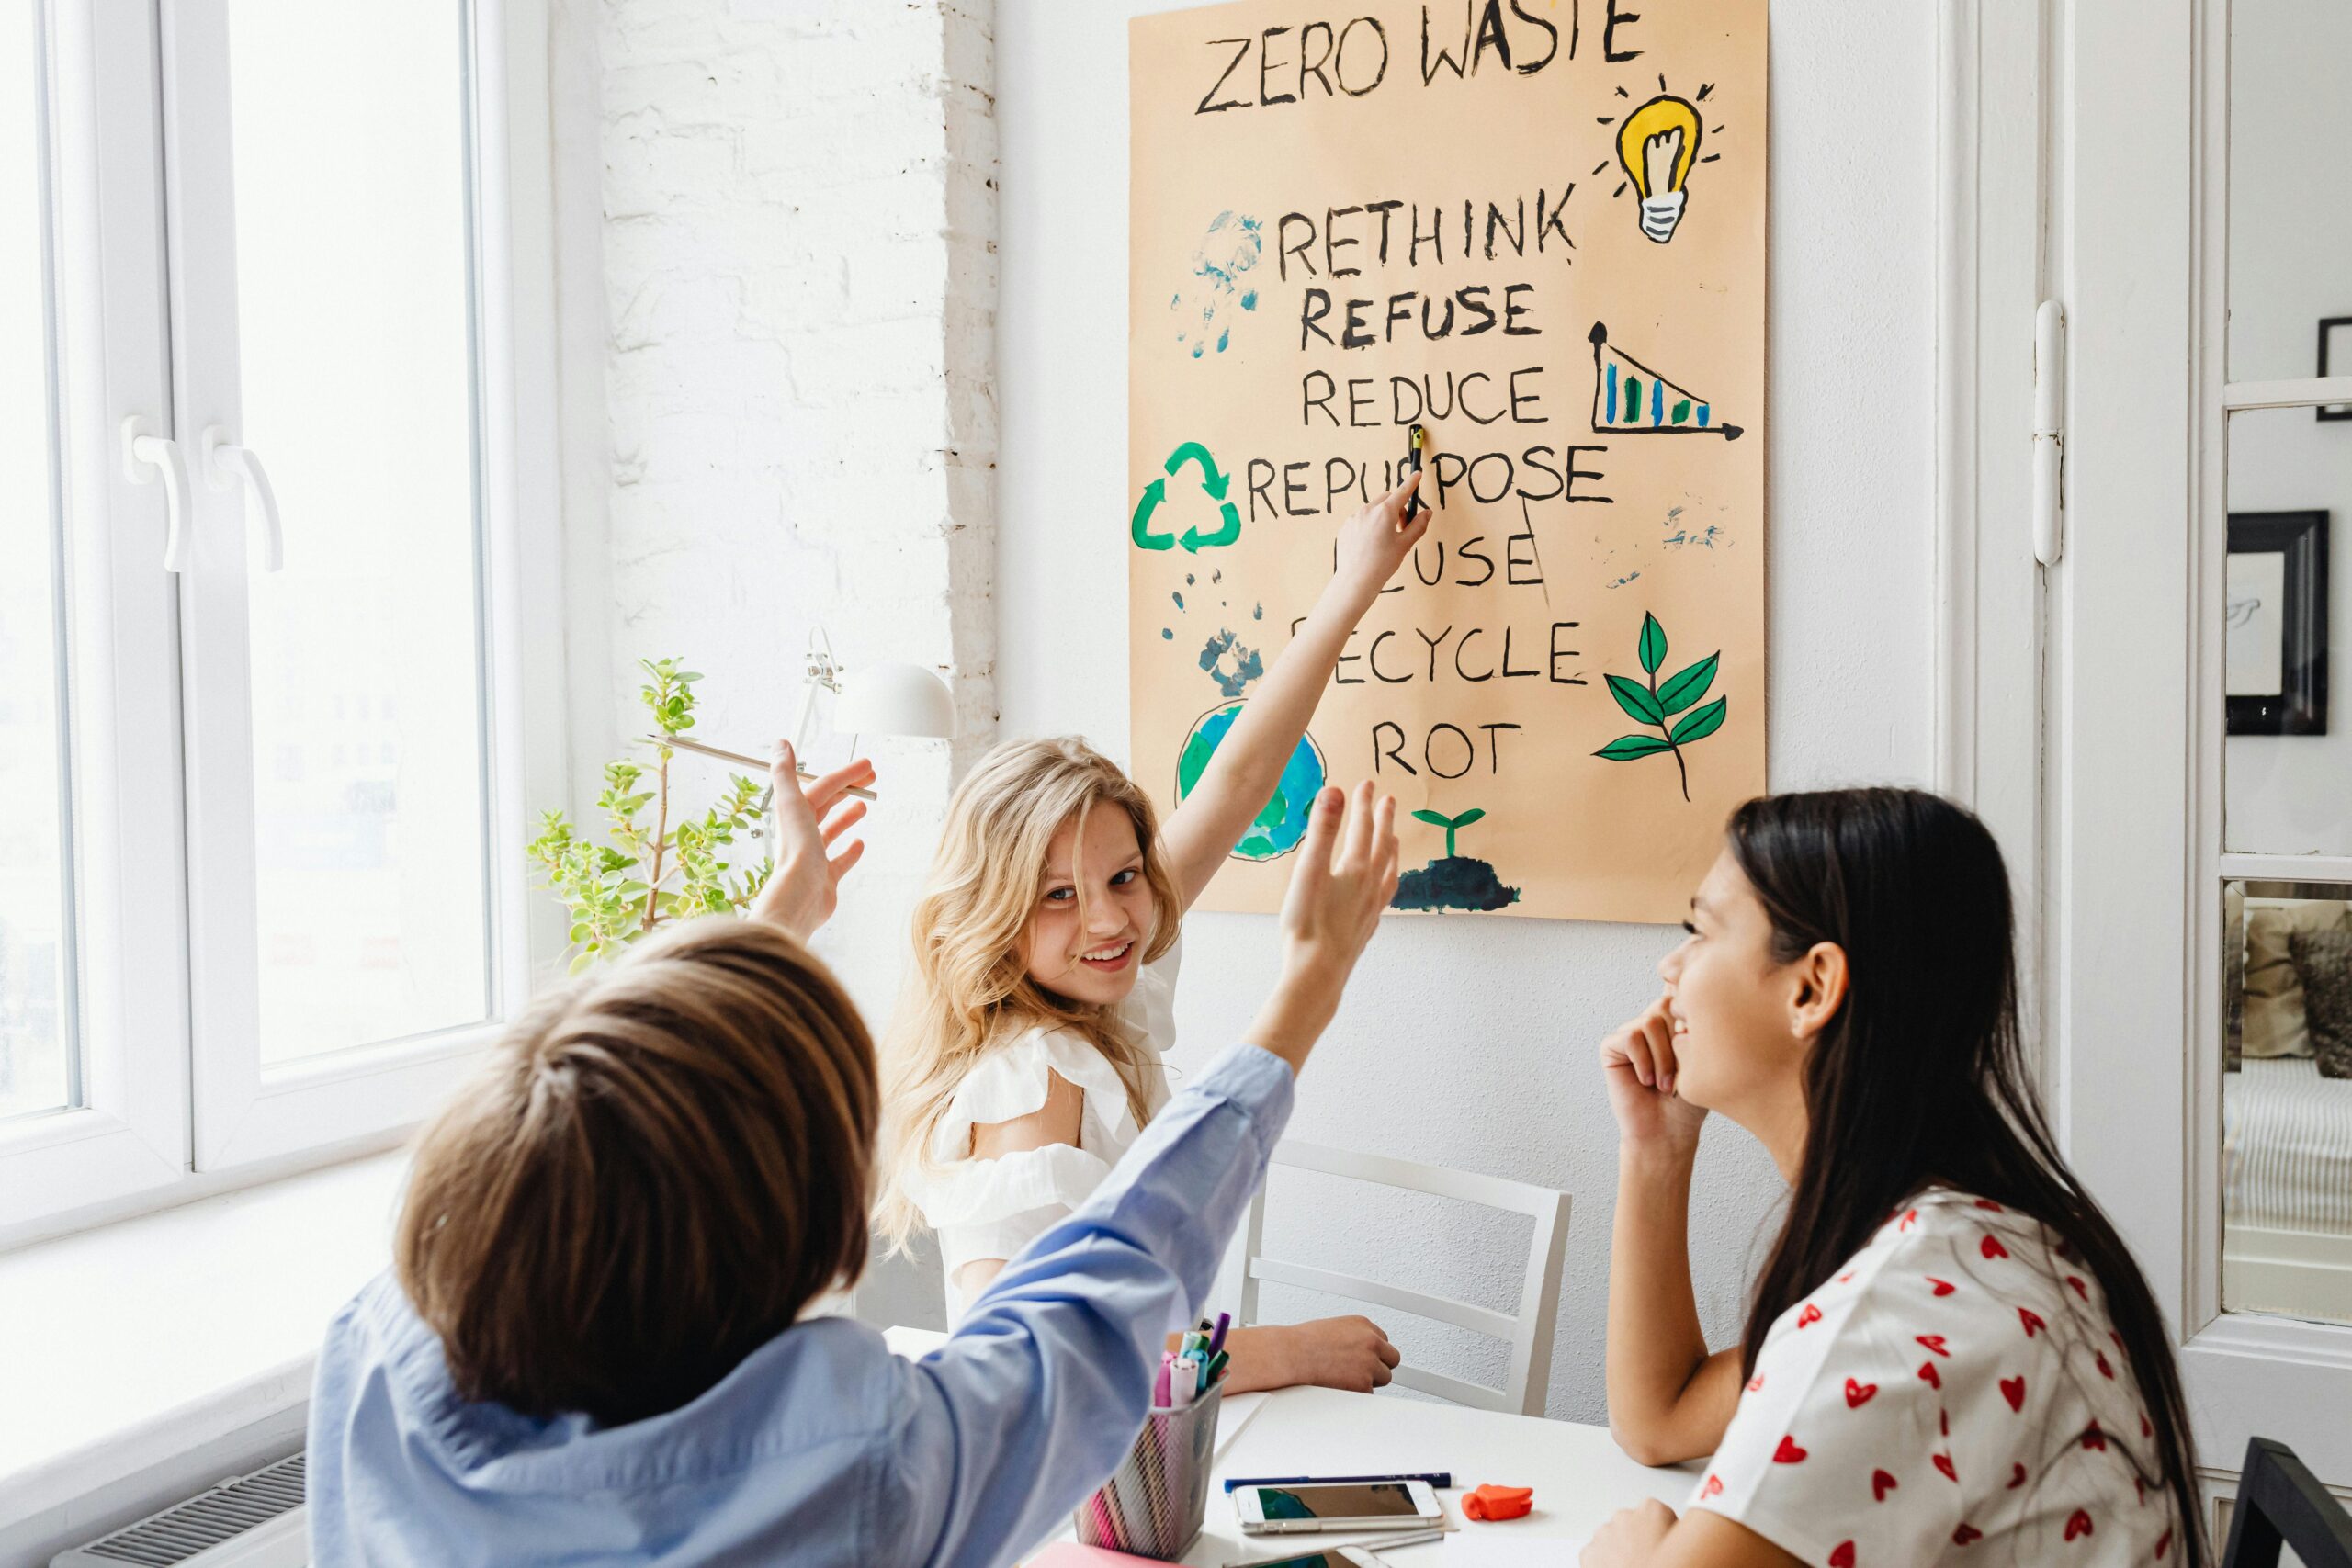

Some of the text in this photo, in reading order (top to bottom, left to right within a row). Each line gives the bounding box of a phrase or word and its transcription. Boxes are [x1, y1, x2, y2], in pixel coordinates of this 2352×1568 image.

[1195, 16, 1389, 116] ZERO
[1278, 182, 1577, 283] RETHINK
[1300, 282, 1543, 351] REFUSE
[1303, 367, 1550, 427] REDUCE
[1333, 533, 1544, 594] USE
[1290, 616, 1589, 685] ECYCLE
[1373, 721, 1522, 779] ROT
